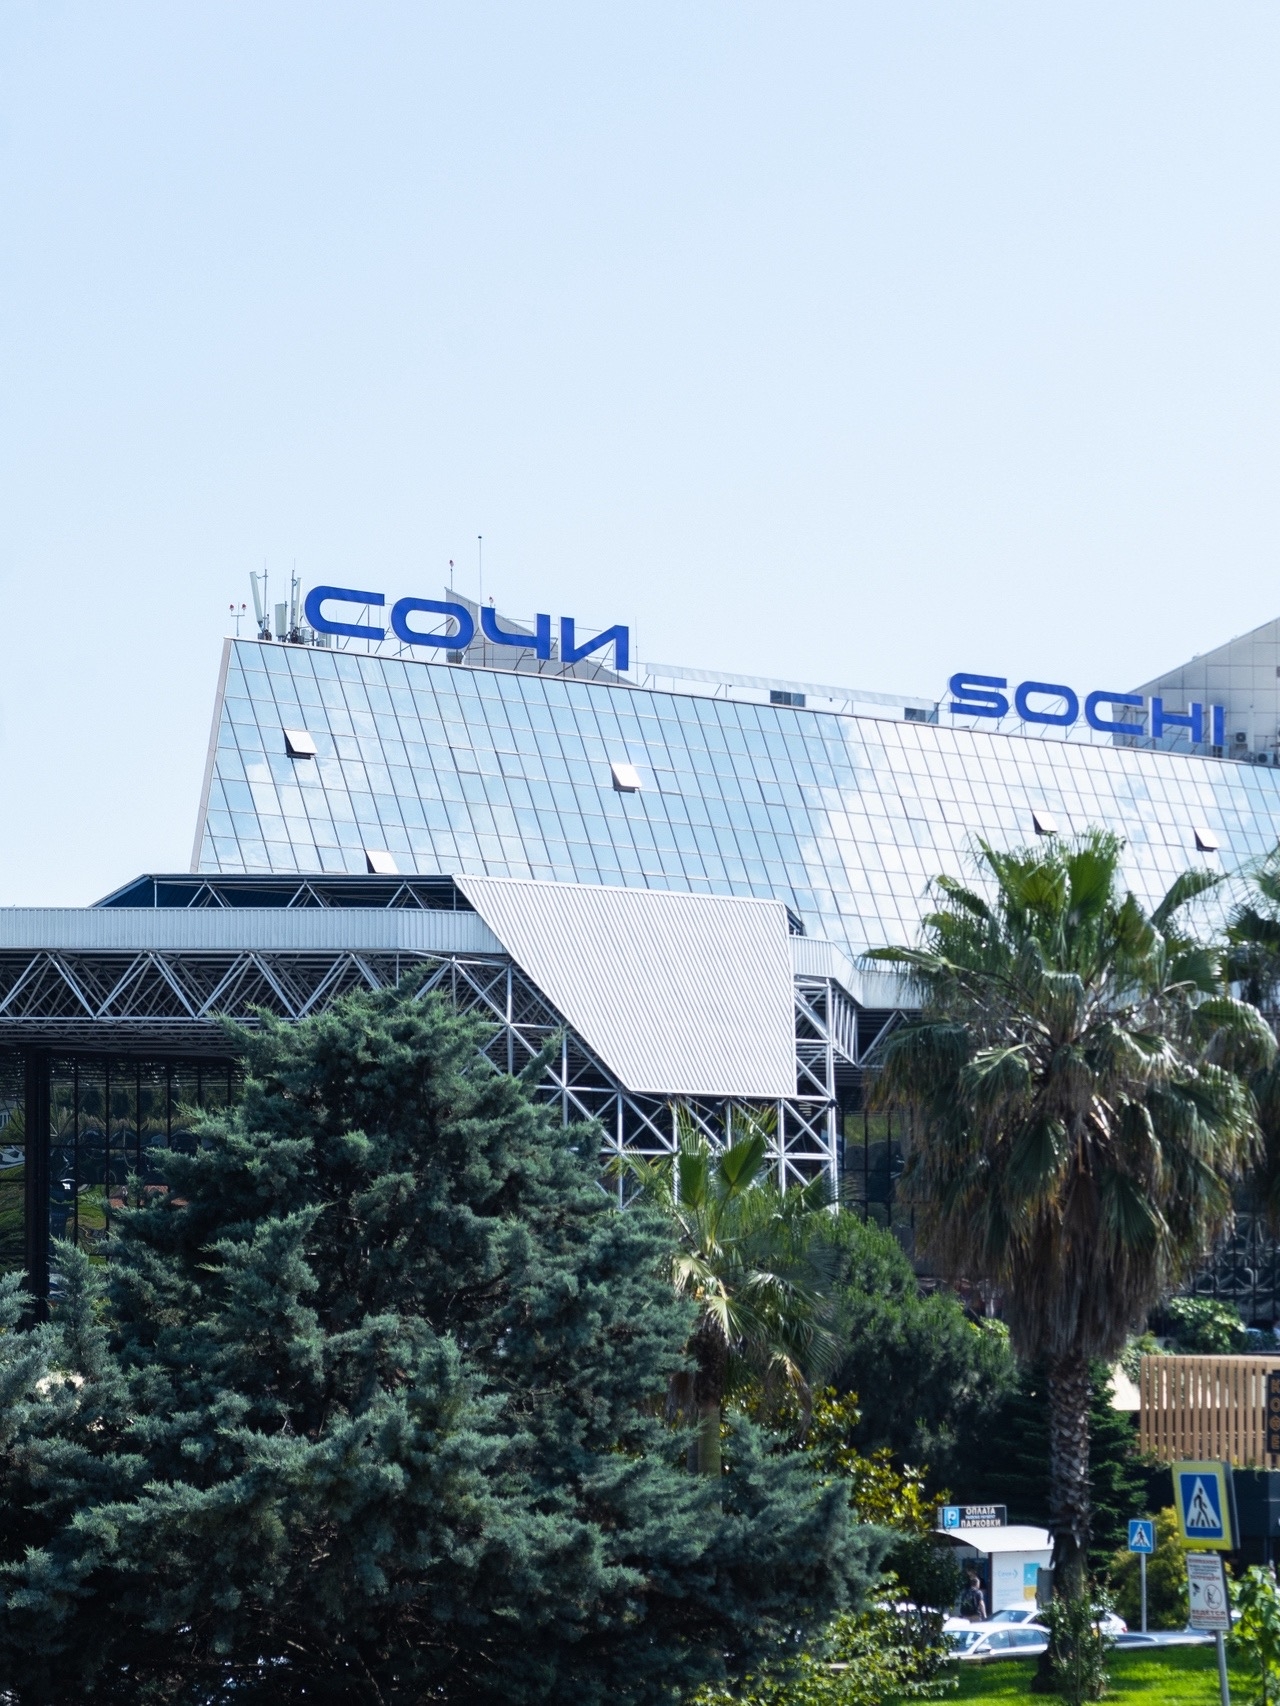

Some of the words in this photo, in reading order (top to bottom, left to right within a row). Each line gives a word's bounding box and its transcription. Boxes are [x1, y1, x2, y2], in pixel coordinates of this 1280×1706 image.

[303, 584, 630, 671] СОЧИ
[948, 671, 1228, 747] SOCHI
[961, 1519, 1001, 1528] ПАРКОВКИ
[966, 1507, 996, 1515] ОПЛАТА
